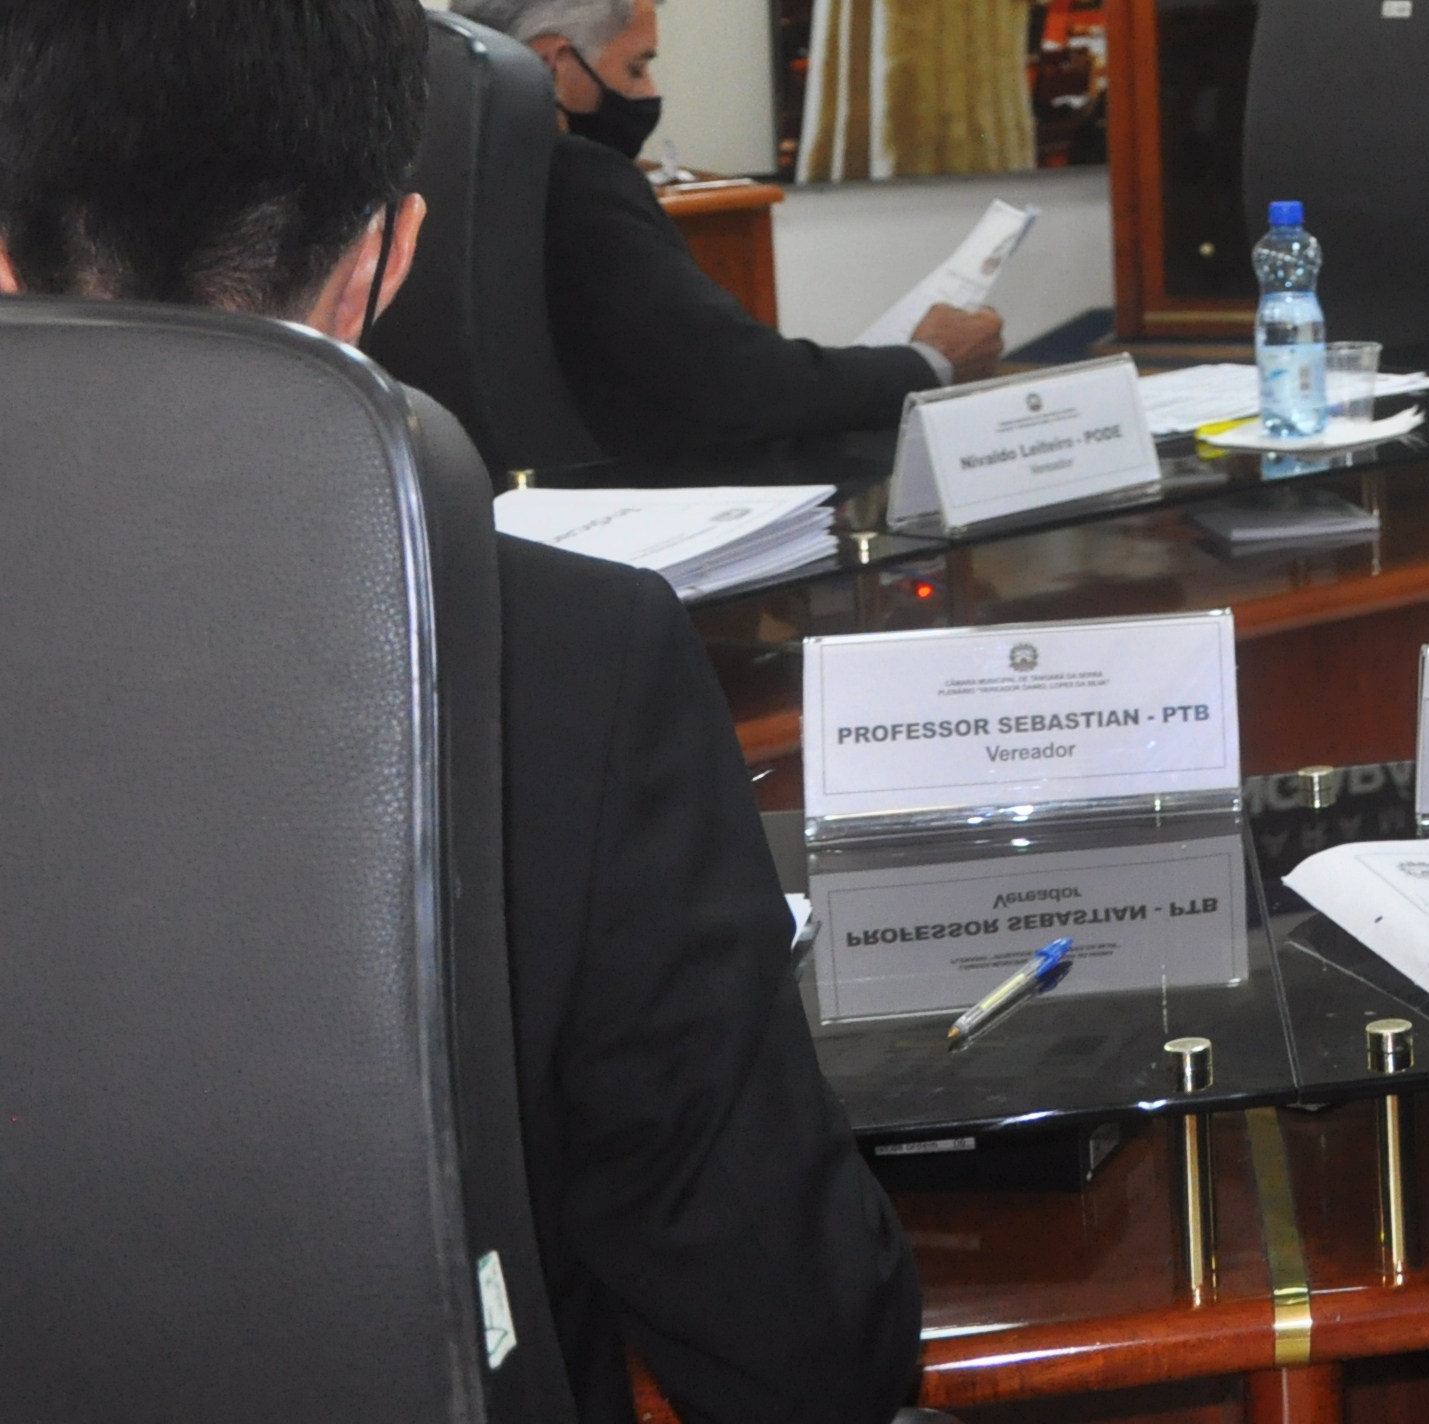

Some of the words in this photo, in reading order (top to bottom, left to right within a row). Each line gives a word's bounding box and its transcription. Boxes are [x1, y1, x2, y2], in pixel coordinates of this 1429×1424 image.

[837, 717, 991, 745] PROFESSOR
[997, 708, 1140, 735] SEBASTIAN
[1161, 703, 1211, 723] PTB
[985, 742, 1077, 763] Vereador
